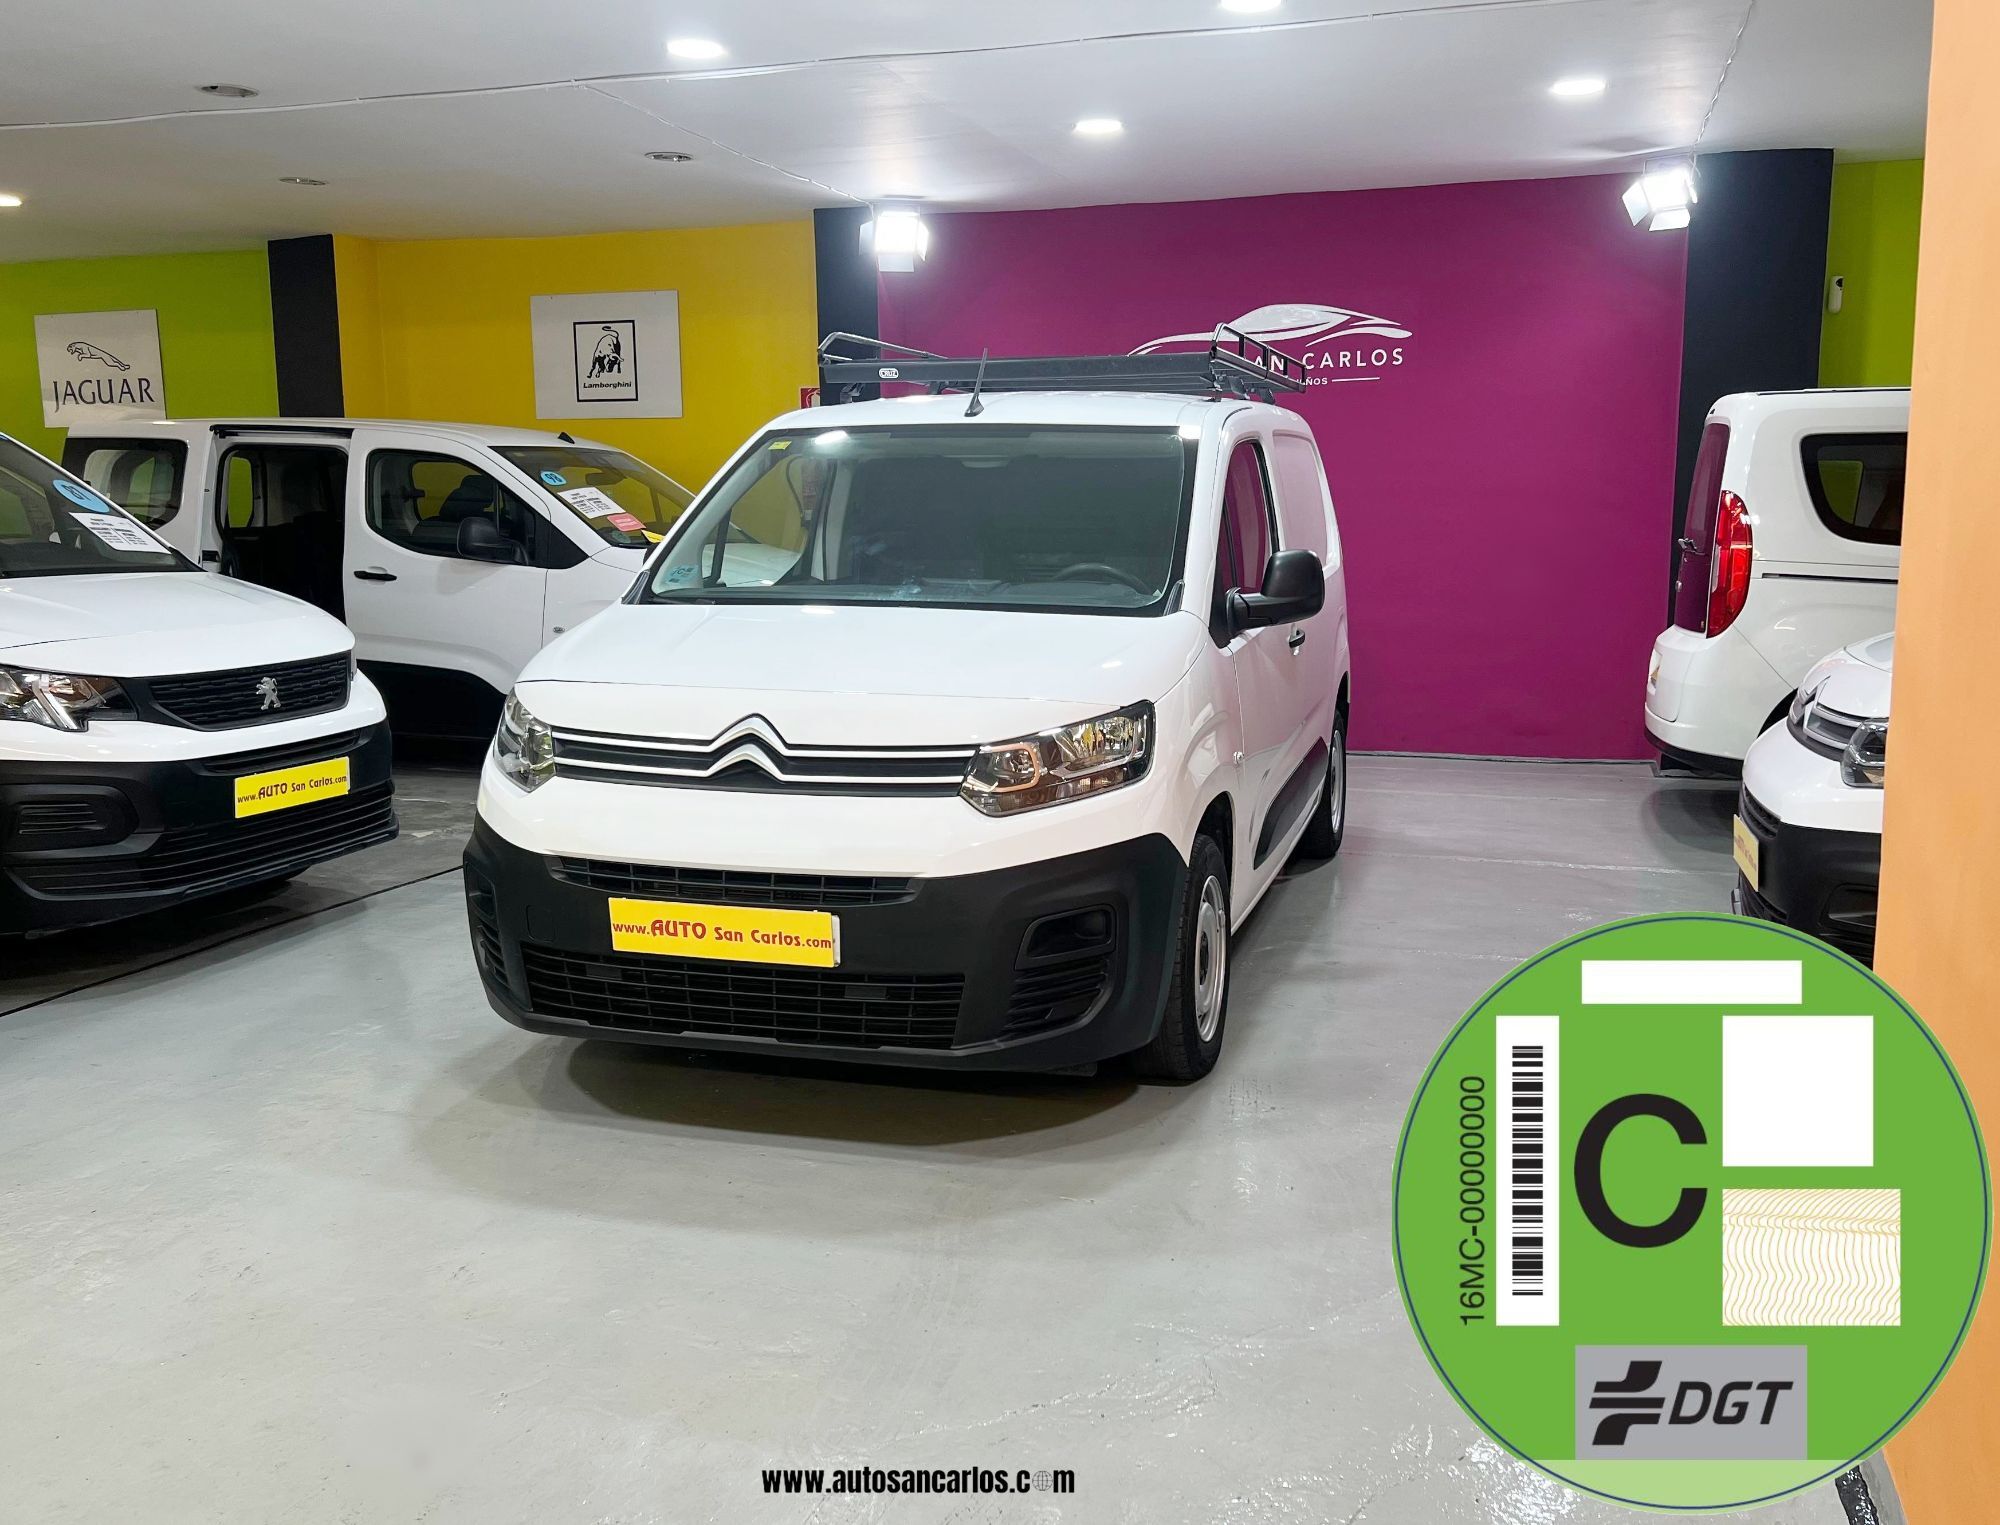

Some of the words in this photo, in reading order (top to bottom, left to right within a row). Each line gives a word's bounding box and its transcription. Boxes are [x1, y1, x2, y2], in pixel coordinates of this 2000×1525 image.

[1253, 355, 1284, 371] AN
[1301, 348, 1404, 370] CARLOS
[53, 377, 155, 412] JAGUAR
[583, 381, 632, 389] Lamborghini
[237, 782, 288, 803] www.AUTO
[291, 782, 306, 792] San
[309, 775, 347, 789] Carlos.com
[612, 919, 706, 940] www.AUTO
[714, 926, 744, 942] San
[750, 929, 832, 949] Carlos.com
